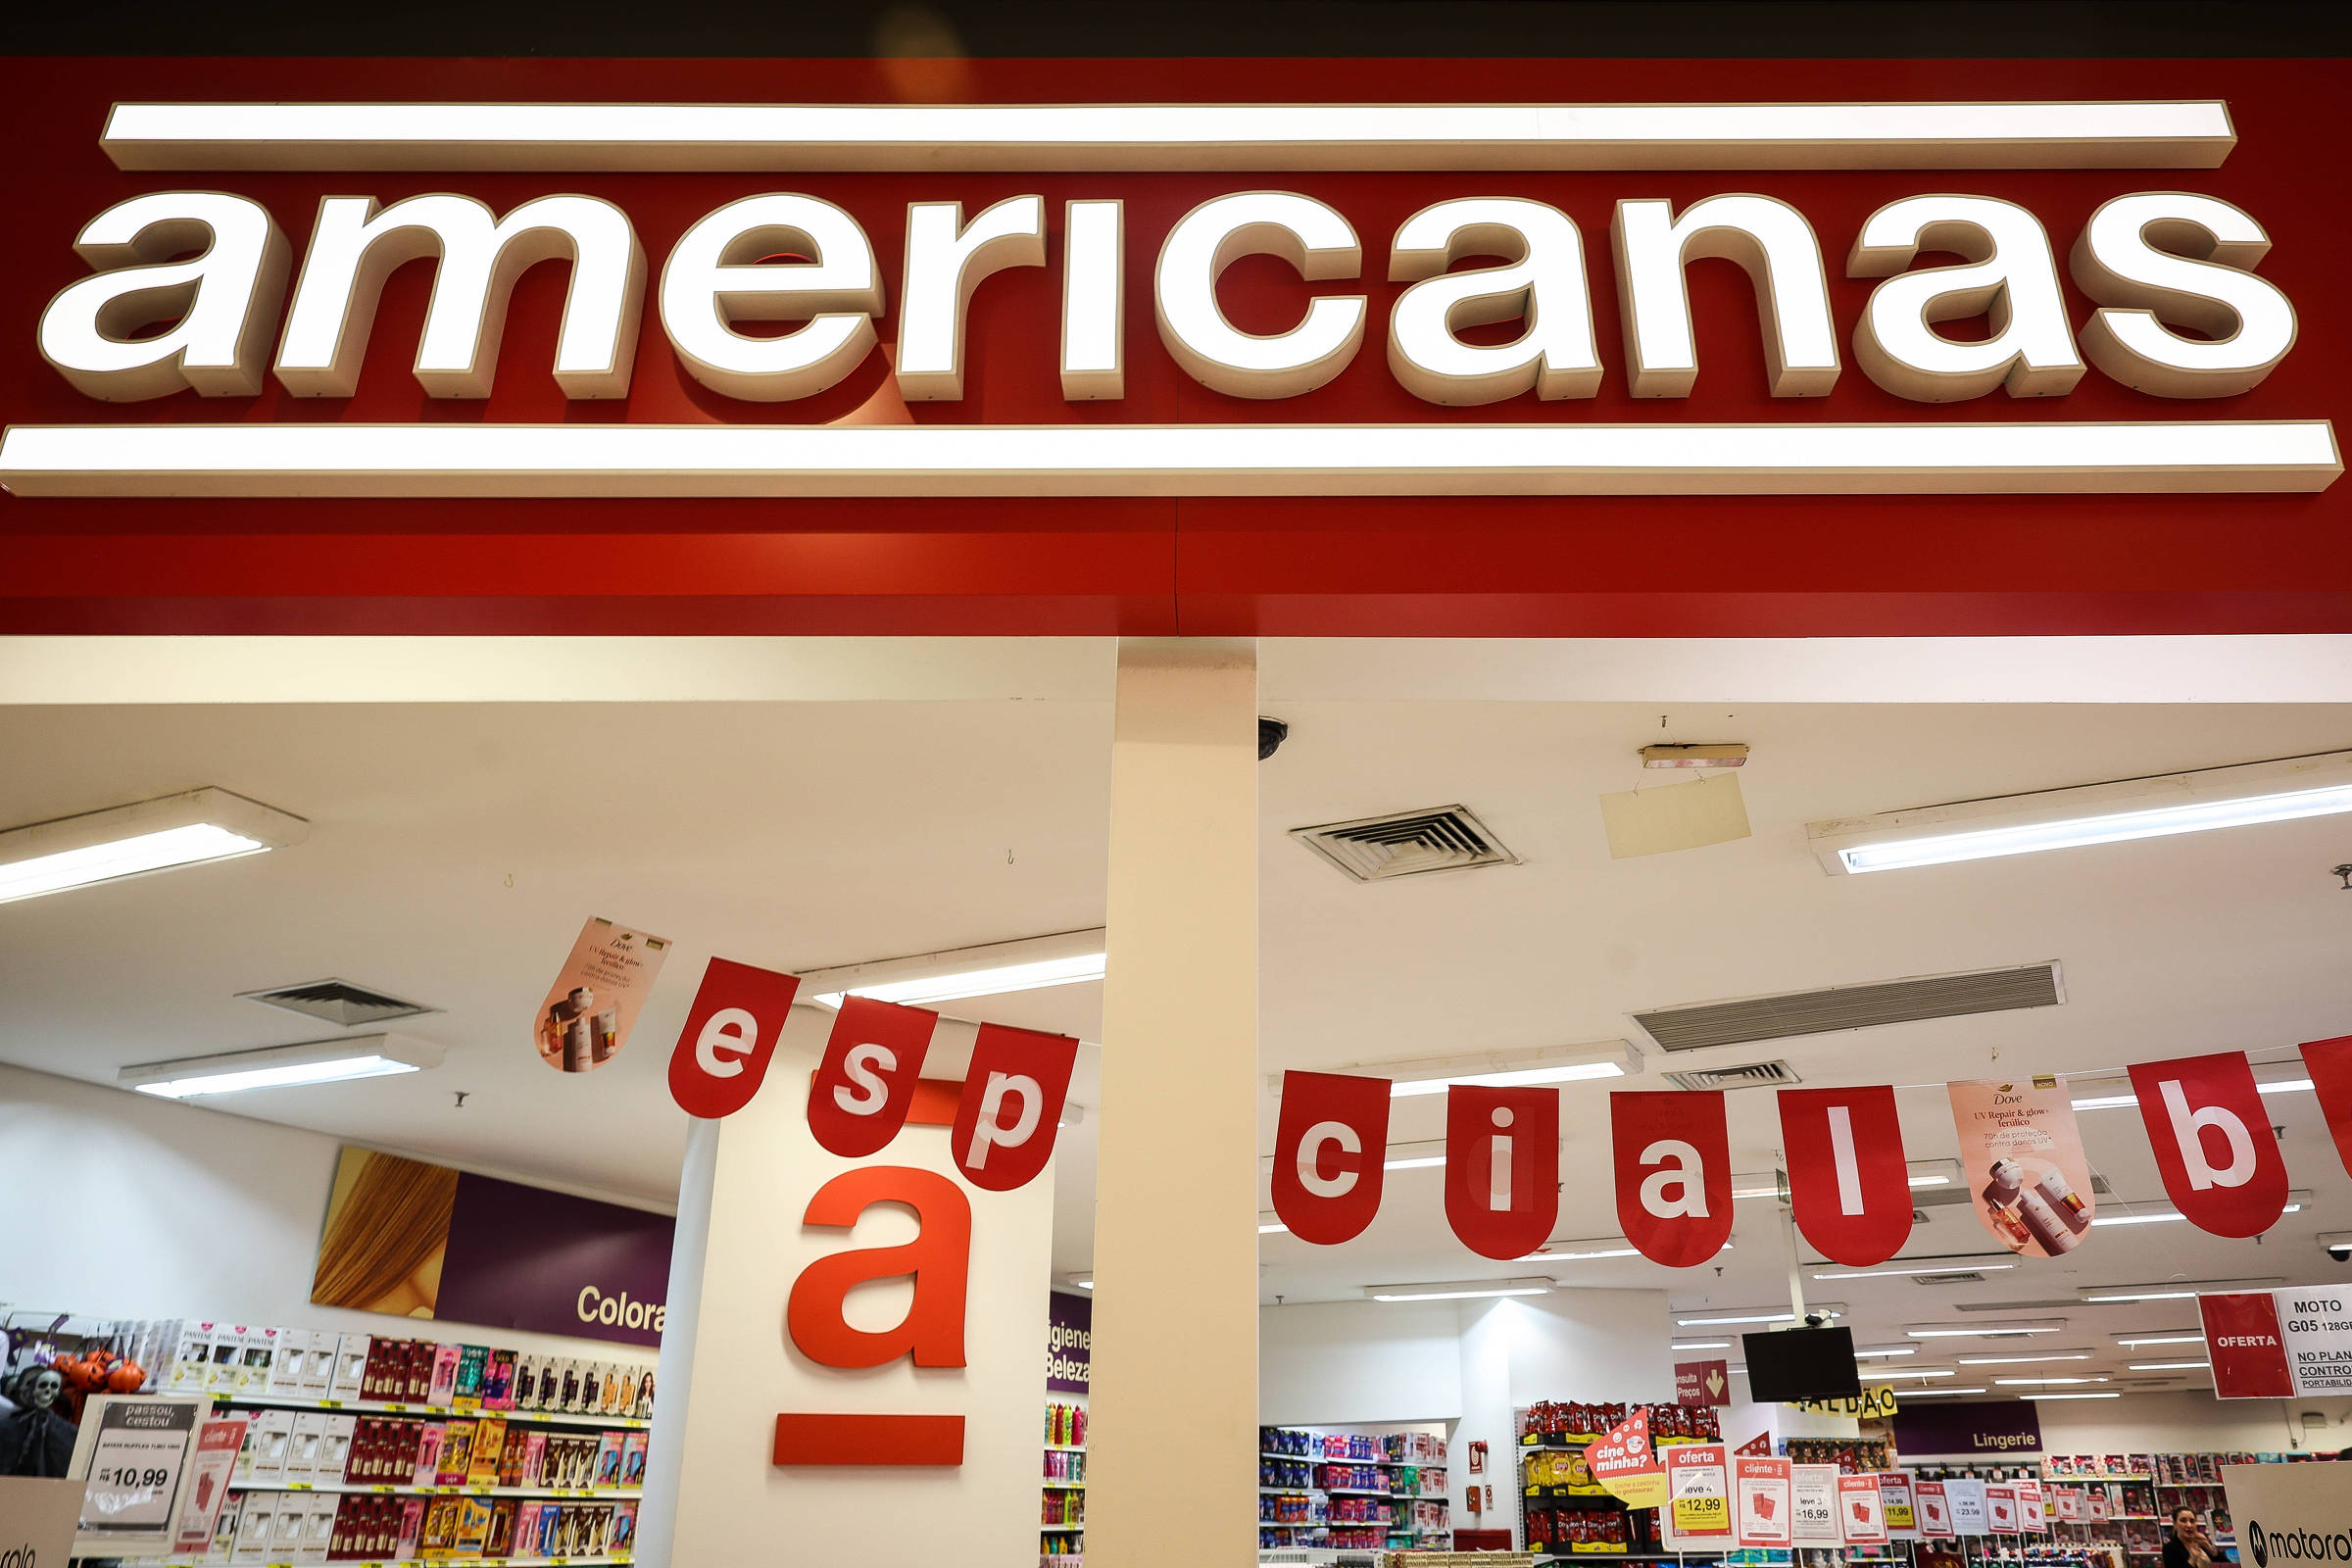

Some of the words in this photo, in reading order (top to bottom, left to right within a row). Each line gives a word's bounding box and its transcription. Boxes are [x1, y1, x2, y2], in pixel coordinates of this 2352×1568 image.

[36, 189, 2298, 403] americanas
[1993, 1093, 2023, 1105] Dove
[1974, 1111, 1987, 1120] UV
[1987, 1109, 2016, 1120] Repair
[2017, 1108, 2025, 1117] &
[2011, 1129, 2047, 1139] proteção
[1984, 1140, 2011, 1149] contra
[2011, 1138, 2037, 1147] danos
[2293, 1299, 2342, 1314] MOTO
[2288, 1319, 2319, 1333] G05
[2217, 1335, 2278, 1348] OFERTA
[2297, 1351, 2317, 1362] NO
[2298, 1365, 2352, 1376] CONTRO
[1677, 1387, 1701, 1399] Preços
[125, 1404, 174, 1418] passou,
[125, 1416, 171, 1428] cestou
[1973, 1432, 2036, 1449] Lingerie
[1596, 1444, 1625, 1460] cine
[1678, 1451, 1715, 1464] oferta
[1596, 1454, 1648, 1472] minha?
[1744, 1463, 1773, 1474] cliente
[113, 1467, 169, 1489] 10,99
[1842, 1479, 1865, 1489] cliente
[1687, 1498, 1721, 1513] 12,99
[1887, 1507, 1909, 1516] 11,99
[1802, 1509, 1829, 1520] 16,99
